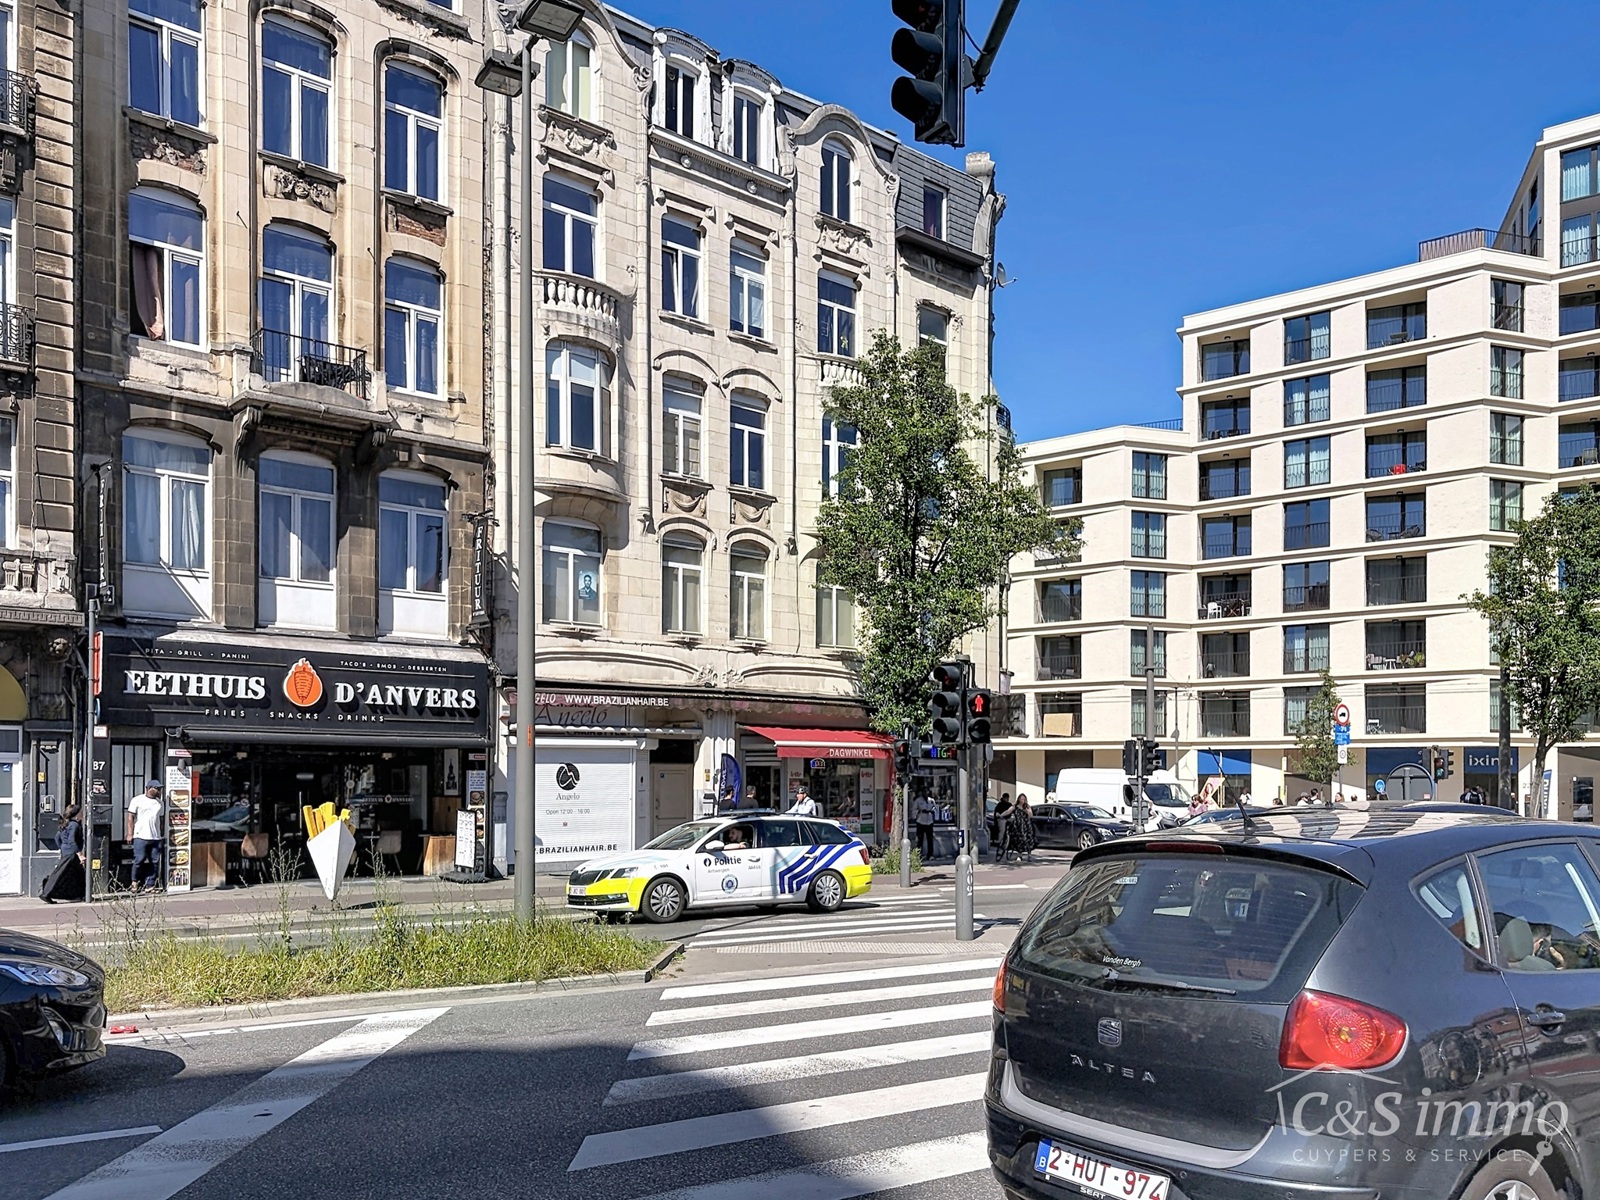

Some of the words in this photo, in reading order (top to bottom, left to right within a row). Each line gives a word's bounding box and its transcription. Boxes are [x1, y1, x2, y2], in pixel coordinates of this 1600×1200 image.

[474, 526, 484, 610] FRITUUR
[177, 649, 203, 657] GRILL
[123, 670, 266, 700] EETHUIS
[334, 682, 477, 709] D'ANVERS
[535, 693, 556, 704] GELO
[564, 695, 670, 707] WWW.BRAZILIANHAIR.BE
[205, 709, 245, 718] FRIES
[269, 711, 319, 720] SNACKS
[338, 714, 385, 723] DRINKS
[829, 748, 873, 757] DAGWINKEL
[1468, 754, 1514, 766] ixin
[555, 792, 581, 801] Angelo
[714, 856, 742, 866] Politie
[1102, 955, 1123, 965] Vanden
[1123, 957, 1142, 968] Bergh
[1070, 1053, 1156, 1083] ALTEA
[1038, 1156, 1046, 1168] B
[1080, 1186, 1107, 1200] SEAT
